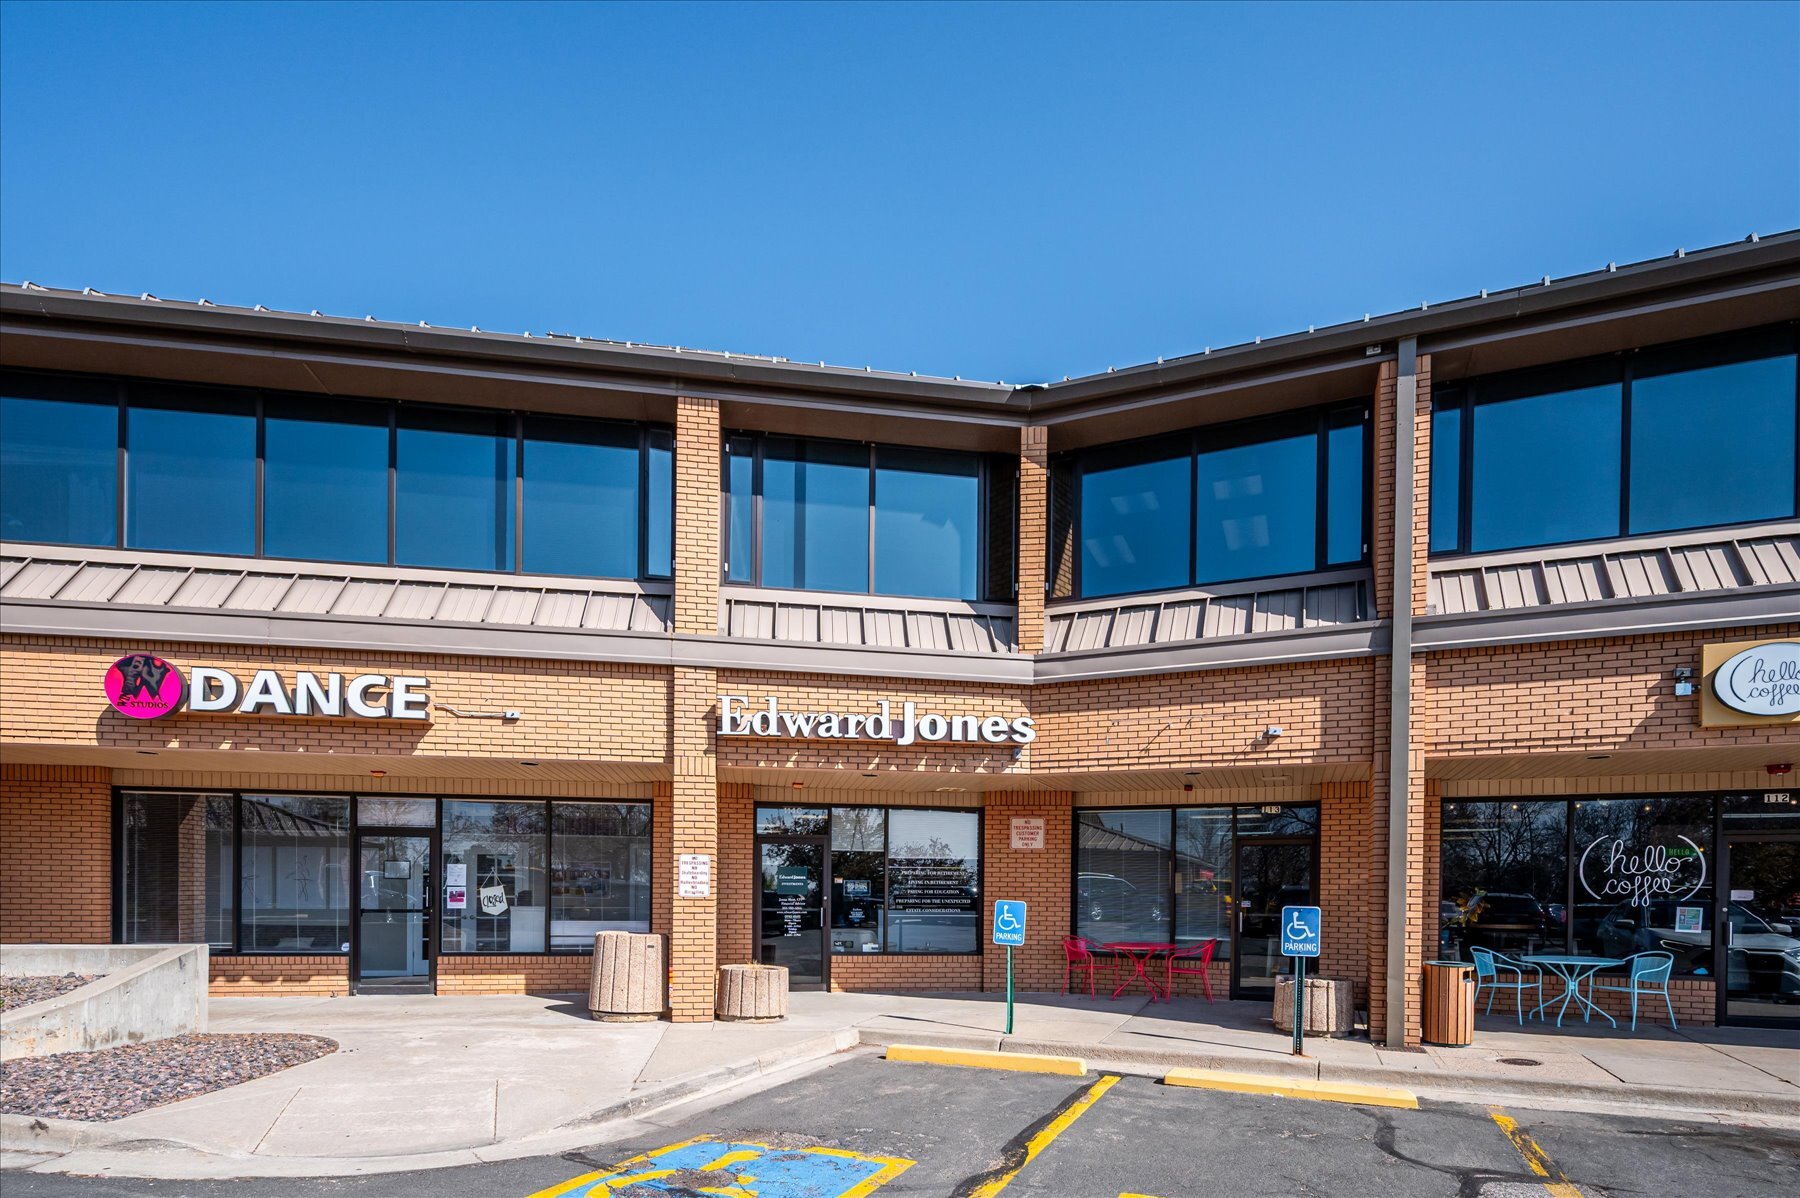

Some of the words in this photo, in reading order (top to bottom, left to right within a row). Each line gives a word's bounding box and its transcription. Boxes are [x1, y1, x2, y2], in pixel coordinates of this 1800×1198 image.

[189, 666, 429, 719] DANCE
[1747, 683, 1800, 706] coffee
[130, 701, 169, 709] STUDIOS
[716, 694, 894, 739] Edward
[896, 700, 1037, 745] Jones
[1766, 794, 1789, 803] 112
[1603, 839, 1693, 874] hello
[1601, 875, 1688, 907] coffee
[995, 932, 1022, 941] PARKING
[1285, 942, 1317, 952] PARKING
